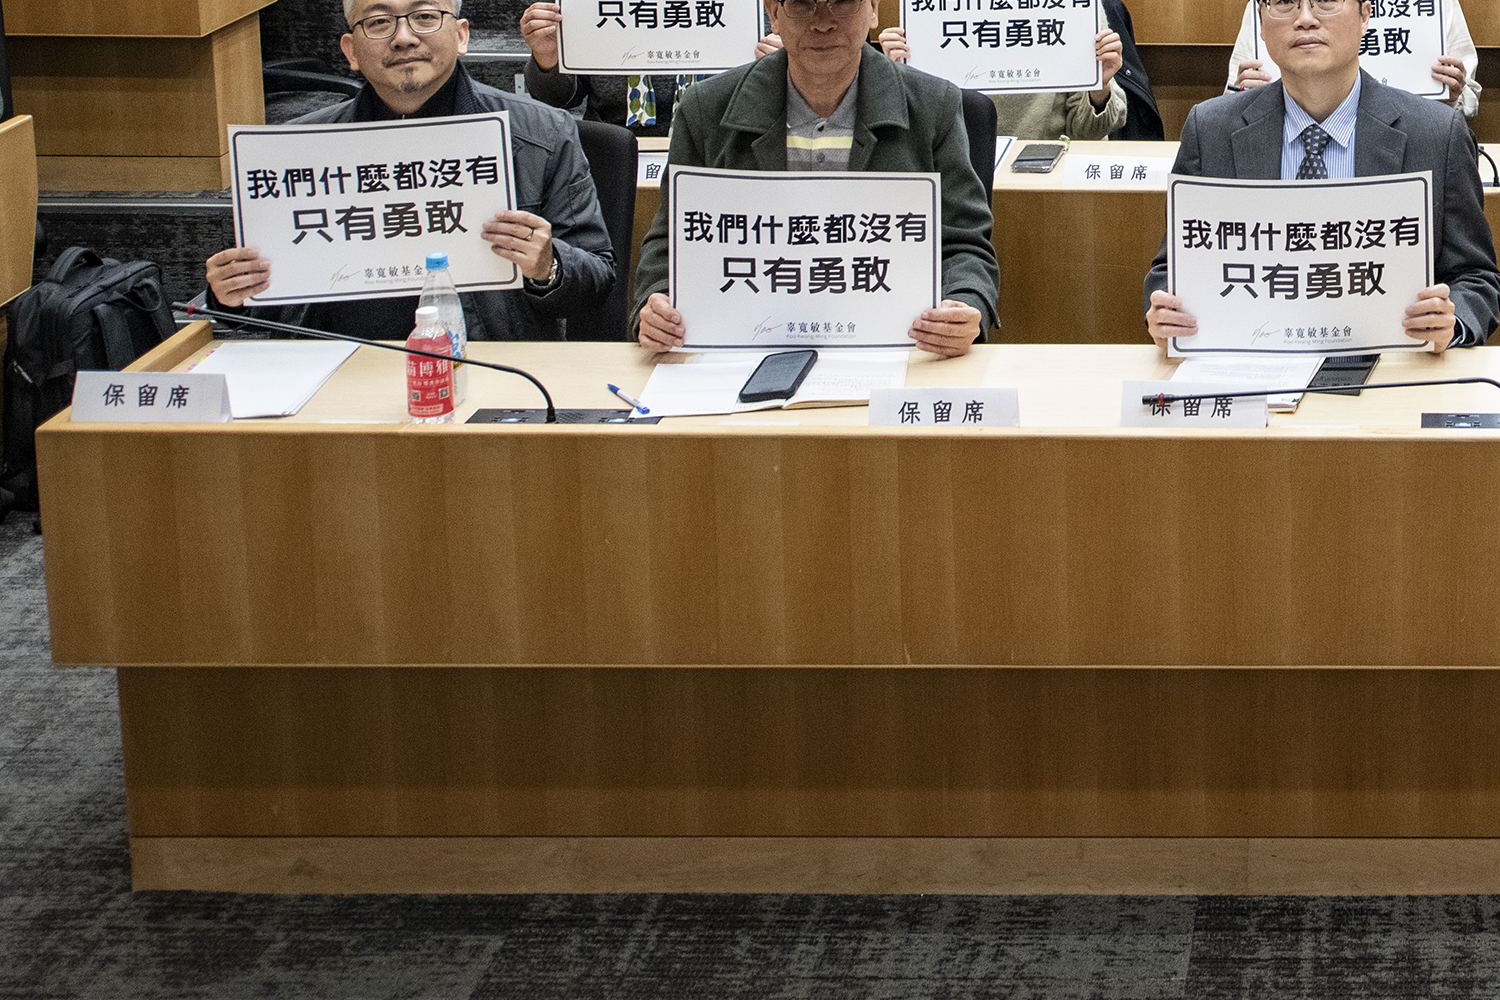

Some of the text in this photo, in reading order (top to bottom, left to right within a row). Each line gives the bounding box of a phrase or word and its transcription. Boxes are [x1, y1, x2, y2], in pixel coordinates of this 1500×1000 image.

[596, 0, 726, 28] 只有勇敢
[940, 19, 1066, 48] 只有勇敢
[247, 155, 498, 199] 我們什麼都沒有
[1085, 164, 1147, 180] 保留席
[292, 200, 468, 244] 只有勇敢
[684, 211, 926, 245] 我們什麼都沒有
[1183, 216, 1419, 252] 我們什麼都沒有
[365, 265, 422, 278] 辜寬敏基金
[720, 256, 891, 294] 只有勇敢
[1220, 261, 1386, 300] 只有勇敢
[103, 384, 189, 408] 保留席
[898, 400, 984, 423] 保留席
